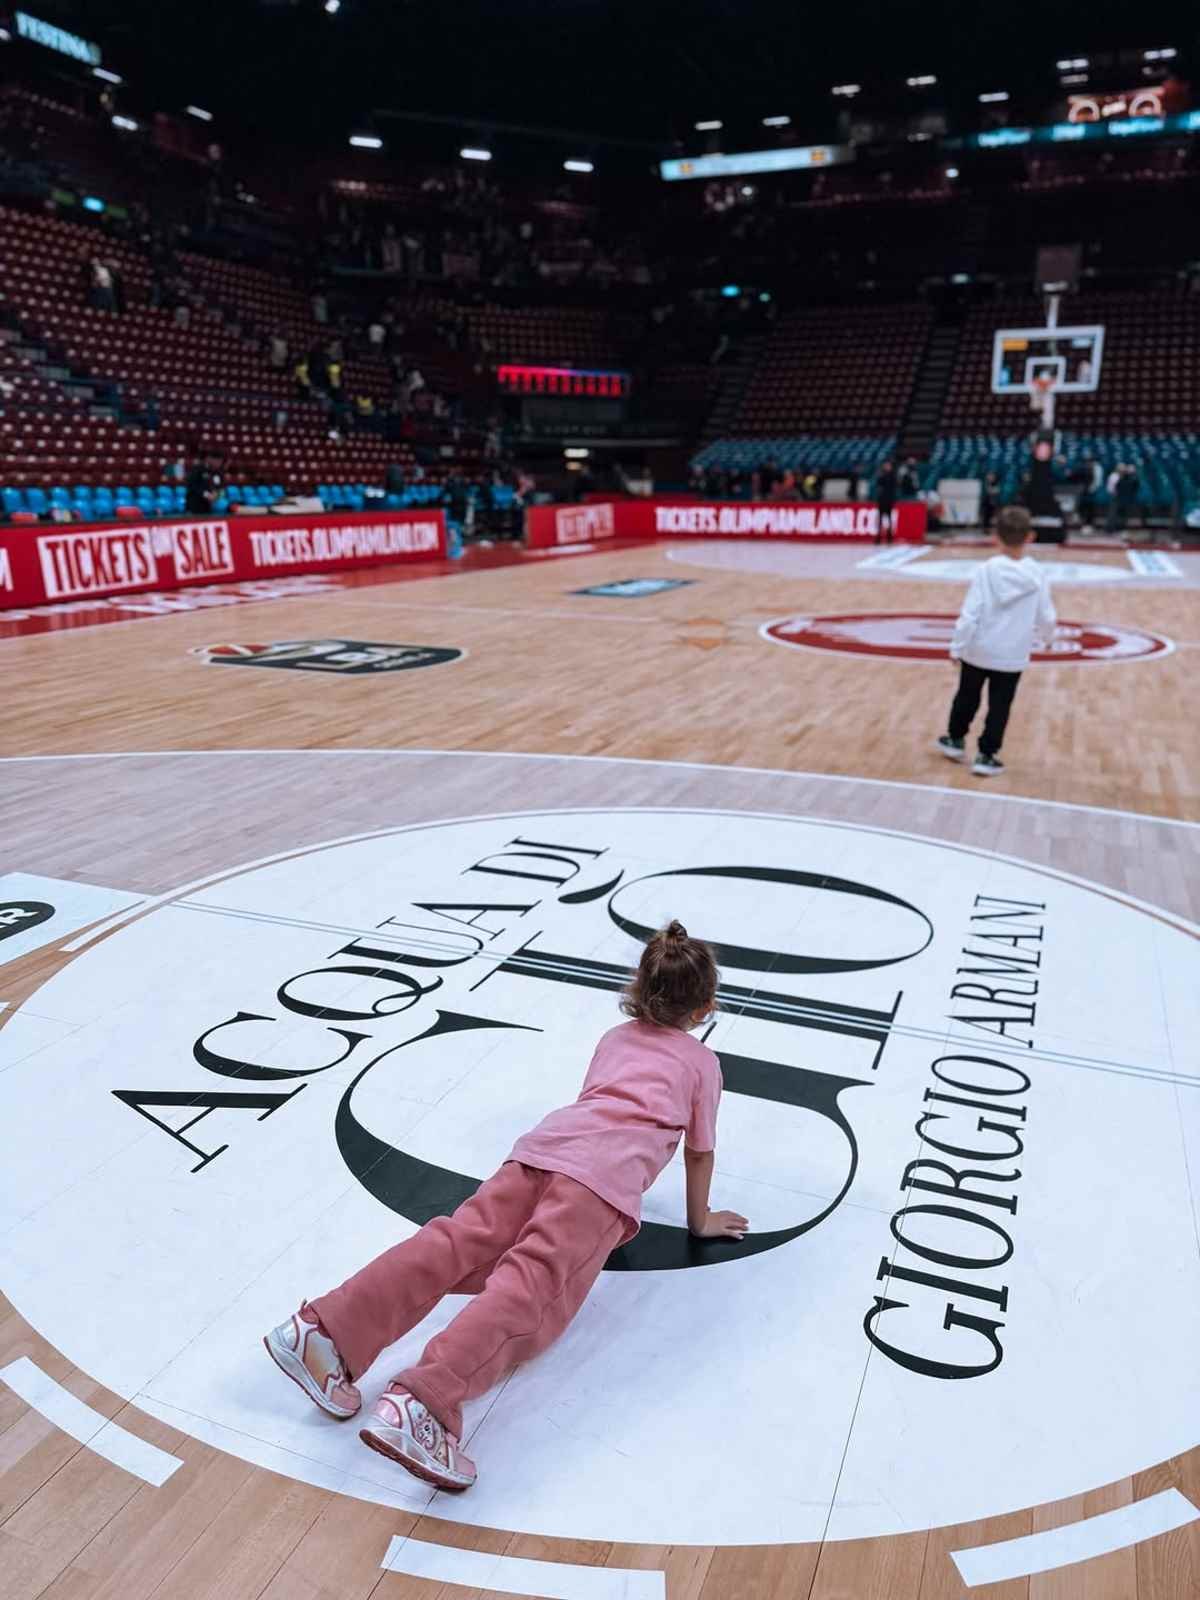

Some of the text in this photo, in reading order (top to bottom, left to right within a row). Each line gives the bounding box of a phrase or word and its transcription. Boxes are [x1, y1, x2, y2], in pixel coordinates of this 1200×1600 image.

[44, 532, 152, 593] TICKETS
[176, 524, 229, 574] SALE
[112, 835, 610, 1174] ACQUA DI
[863, 894, 1047, 1380] GIORGIO ARMANI
